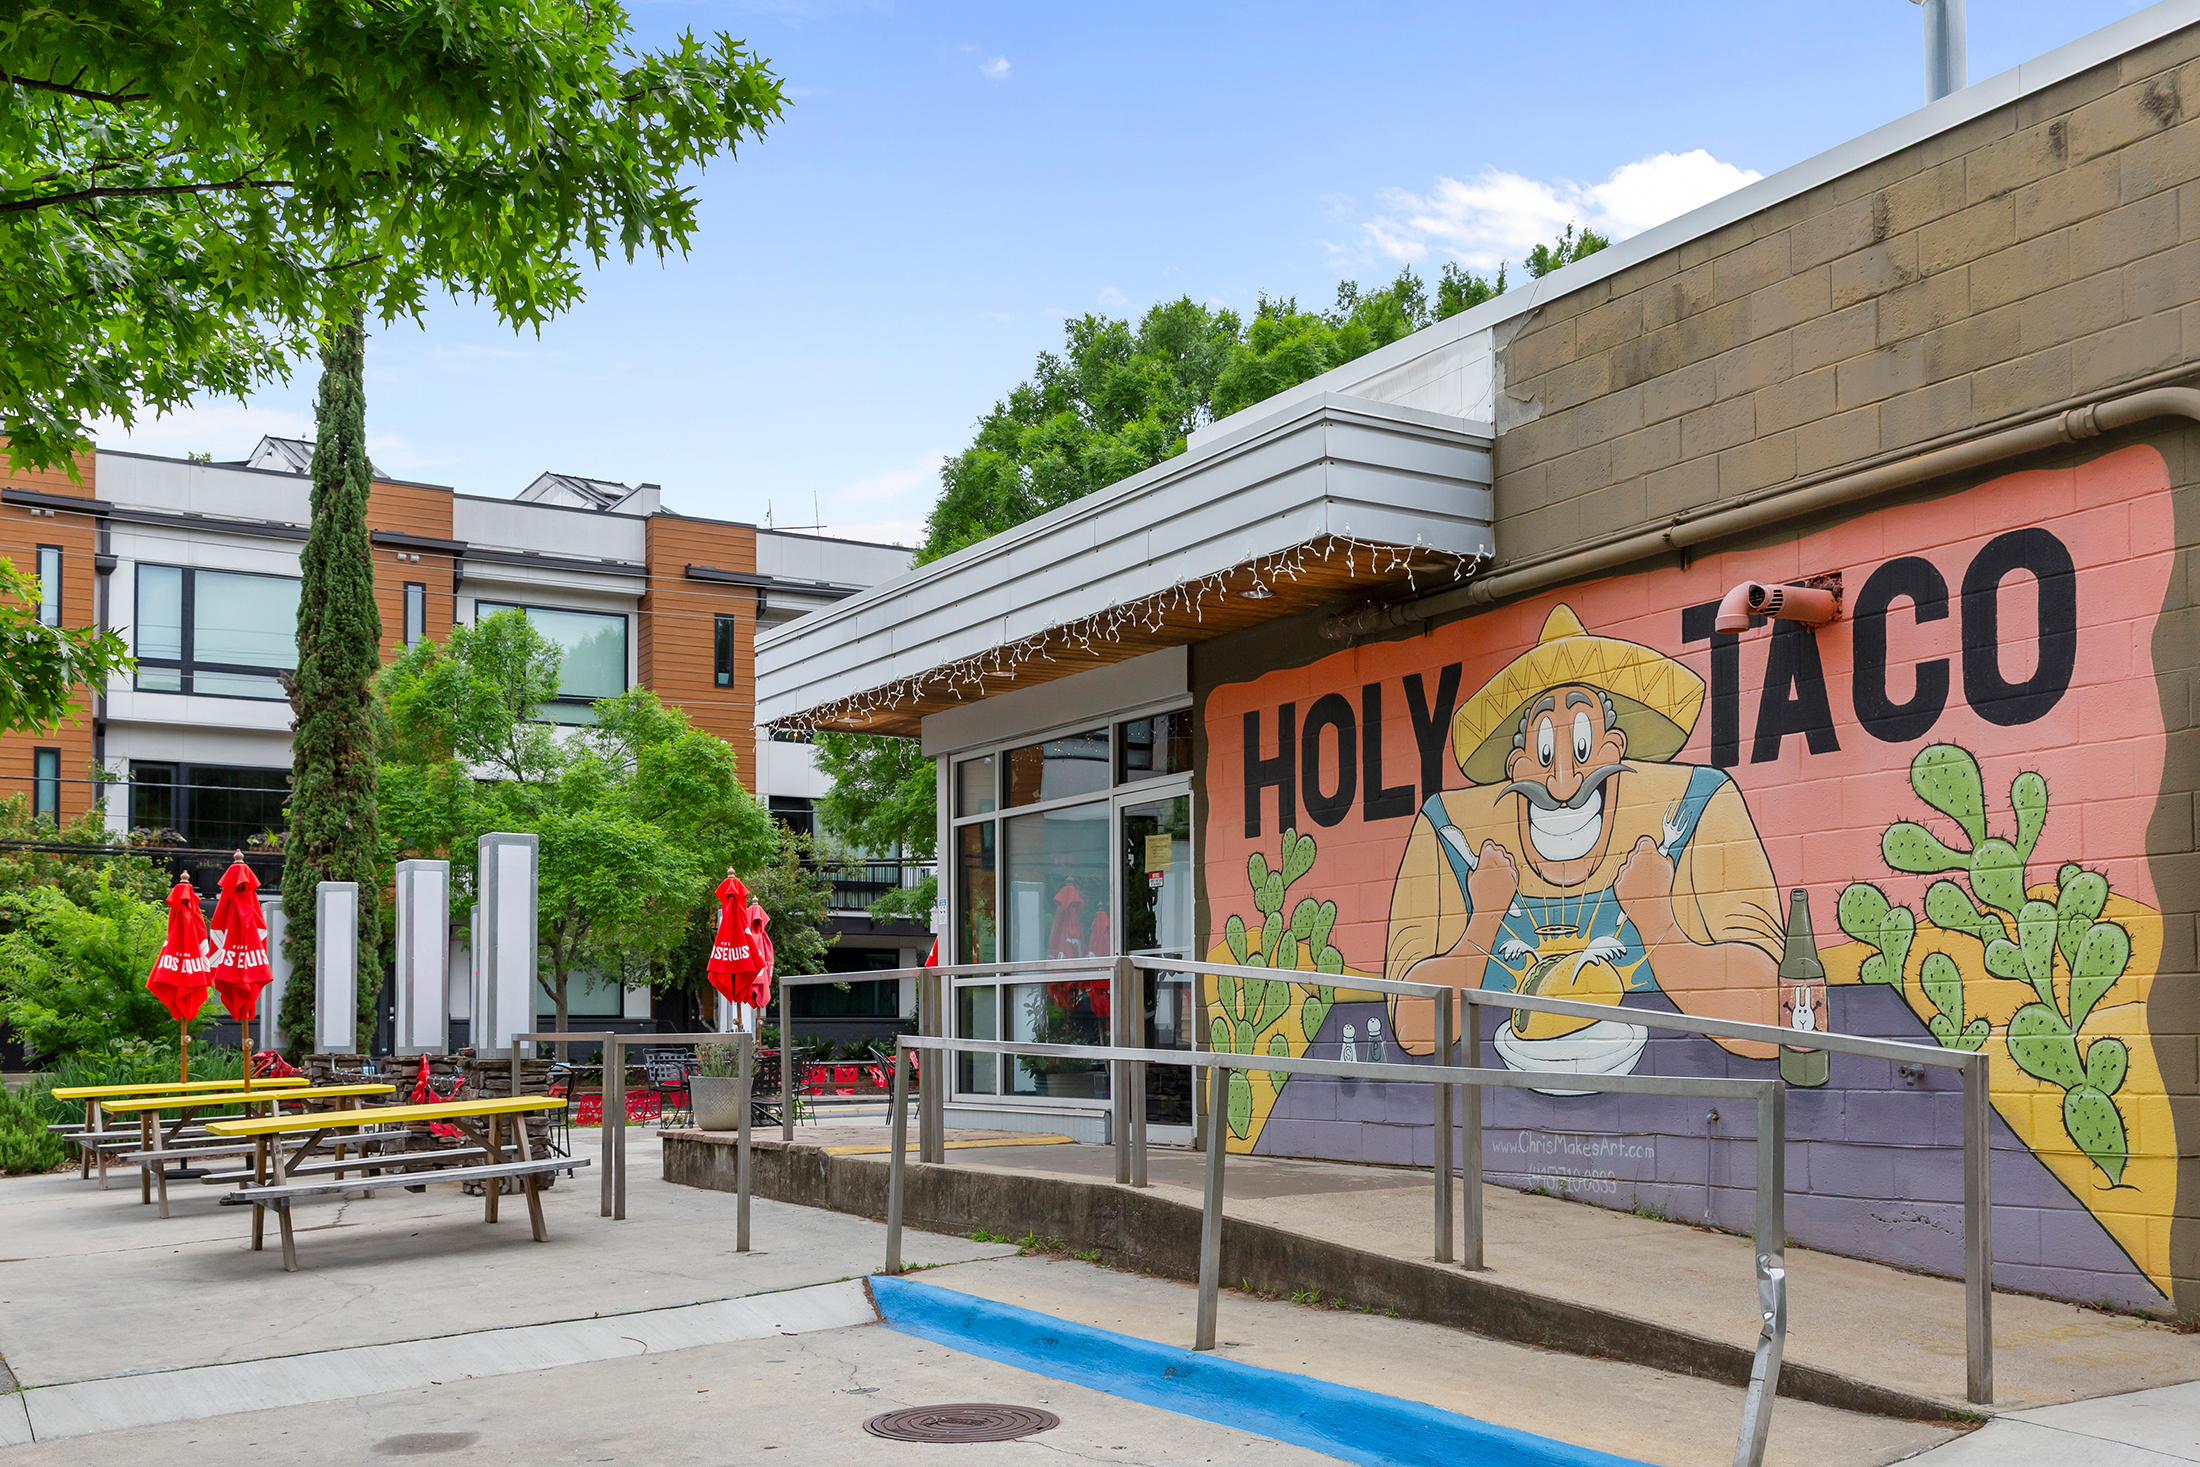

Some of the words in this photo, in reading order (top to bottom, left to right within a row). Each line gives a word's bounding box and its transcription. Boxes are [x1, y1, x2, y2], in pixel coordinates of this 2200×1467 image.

[1243, 661, 1462, 839] HOLY
[1682, 527, 2077, 767] TACO
[1492, 1132, 1655, 1158] www.ChrisMakesArt.com
